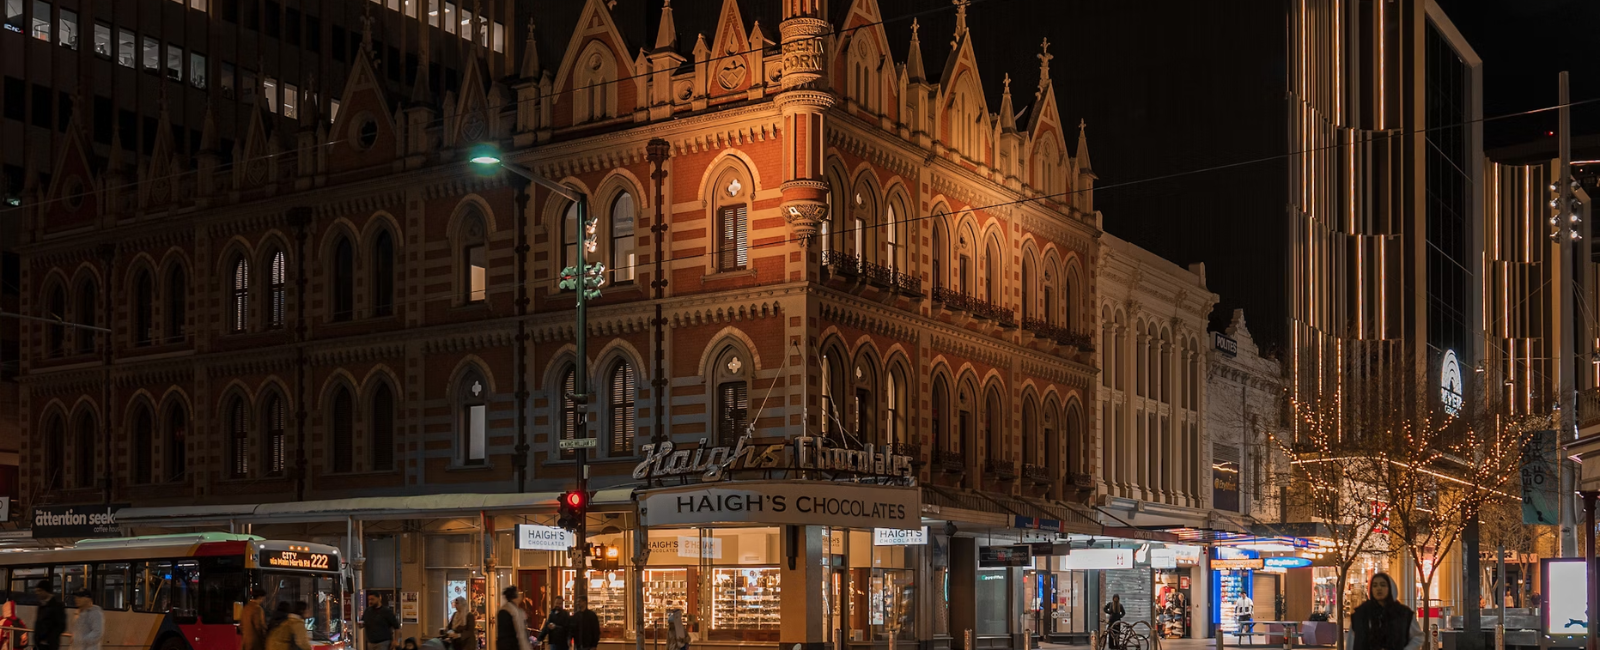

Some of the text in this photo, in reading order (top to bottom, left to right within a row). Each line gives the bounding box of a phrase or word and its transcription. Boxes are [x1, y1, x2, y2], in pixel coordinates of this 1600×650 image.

[1217, 335, 1236, 353] POLITES
[1533, 465, 1544, 485] OF
[1522, 468, 1532, 505] STEP
[677, 495, 786, 513] HAIGH'S
[796, 496, 905, 520] CHOCOLATES
[35, 509, 86, 526] attention
[94, 524, 120, 533] coffee hous
[528, 530, 565, 540] HAIGH'S
[879, 530, 922, 538] HAIGHS
[278, 558, 289, 566] Main
[290, 559, 303, 567] North
[282, 551, 297, 559] CITY
[311, 554, 328, 569] 222
